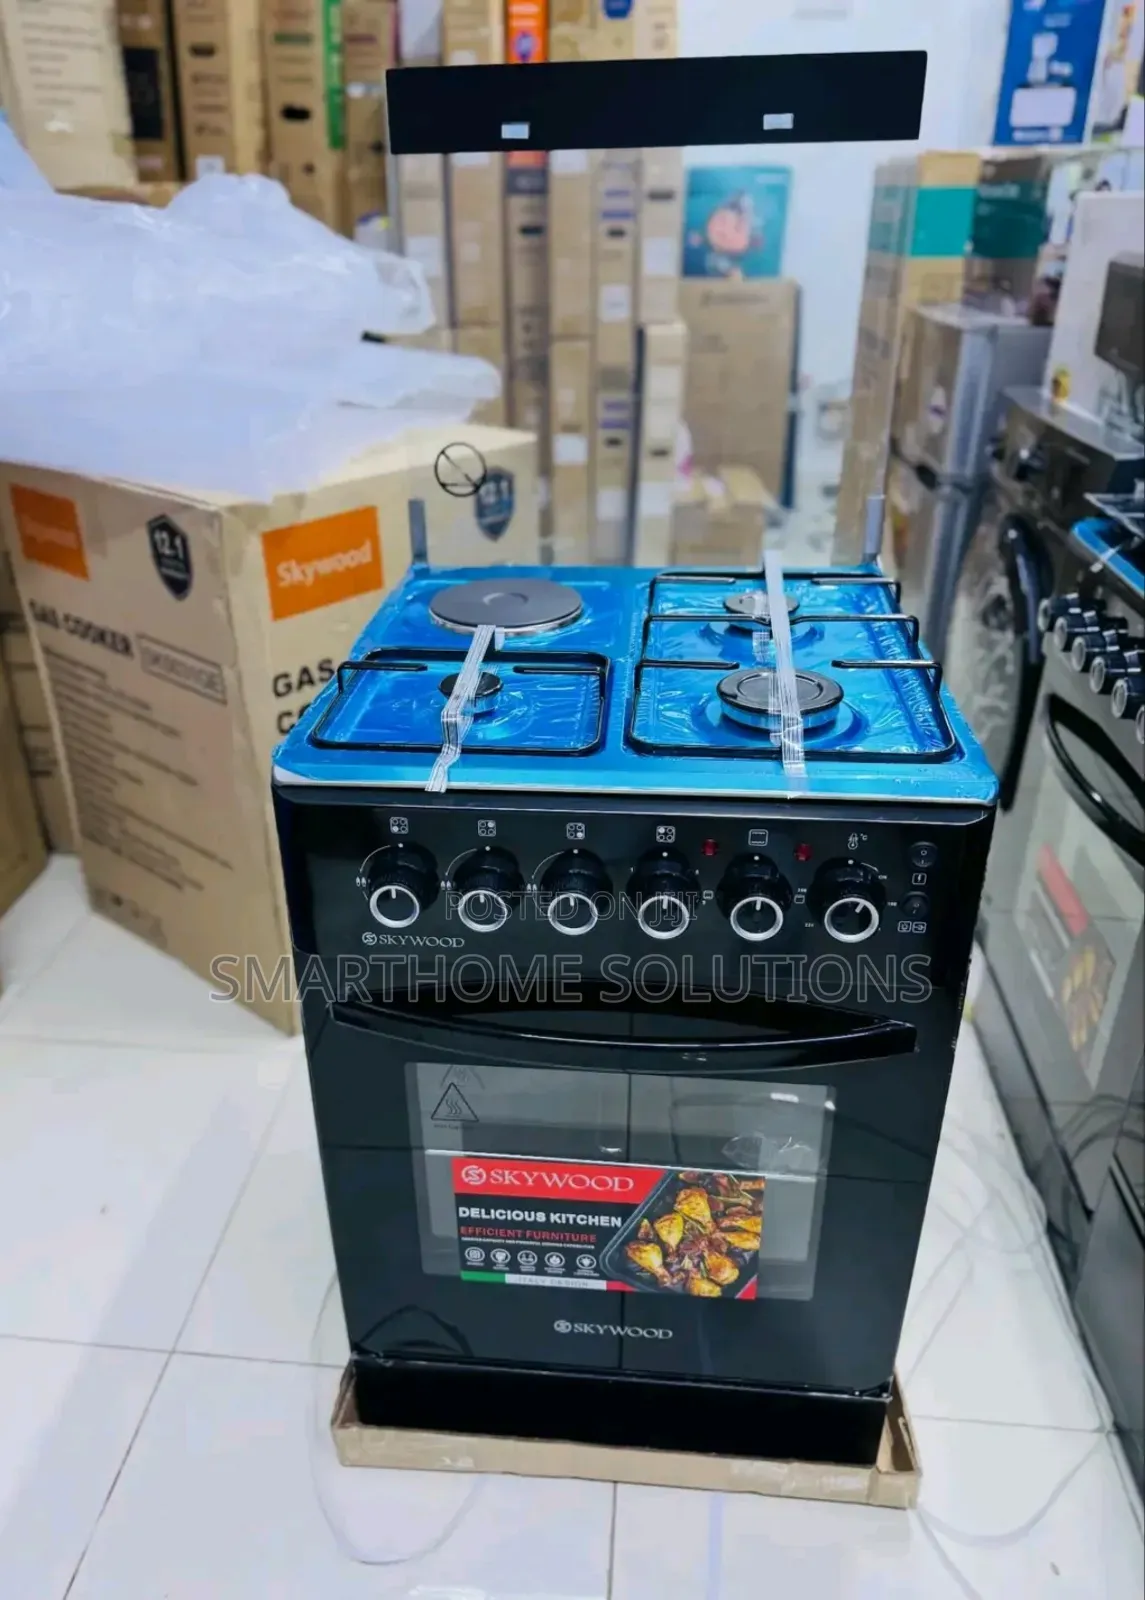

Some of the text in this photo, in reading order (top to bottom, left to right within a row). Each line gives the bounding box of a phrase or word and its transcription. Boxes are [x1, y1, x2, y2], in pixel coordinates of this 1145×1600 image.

[275, 540, 373, 587] Skywood
[272, 658, 334, 698] GAS
[378, 934, 465, 948] SKYWOOD
[489, 1168, 635, 1192] SKYWOOD
[458, 1206, 622, 1228] DELICIOUS KITCHEN
[460, 1225, 597, 1243] EFFICIENT FURNITURE
[517, 1275, 589, 1289] ITALY DESIGN
[573, 1322, 674, 1340] SKYWOOD
